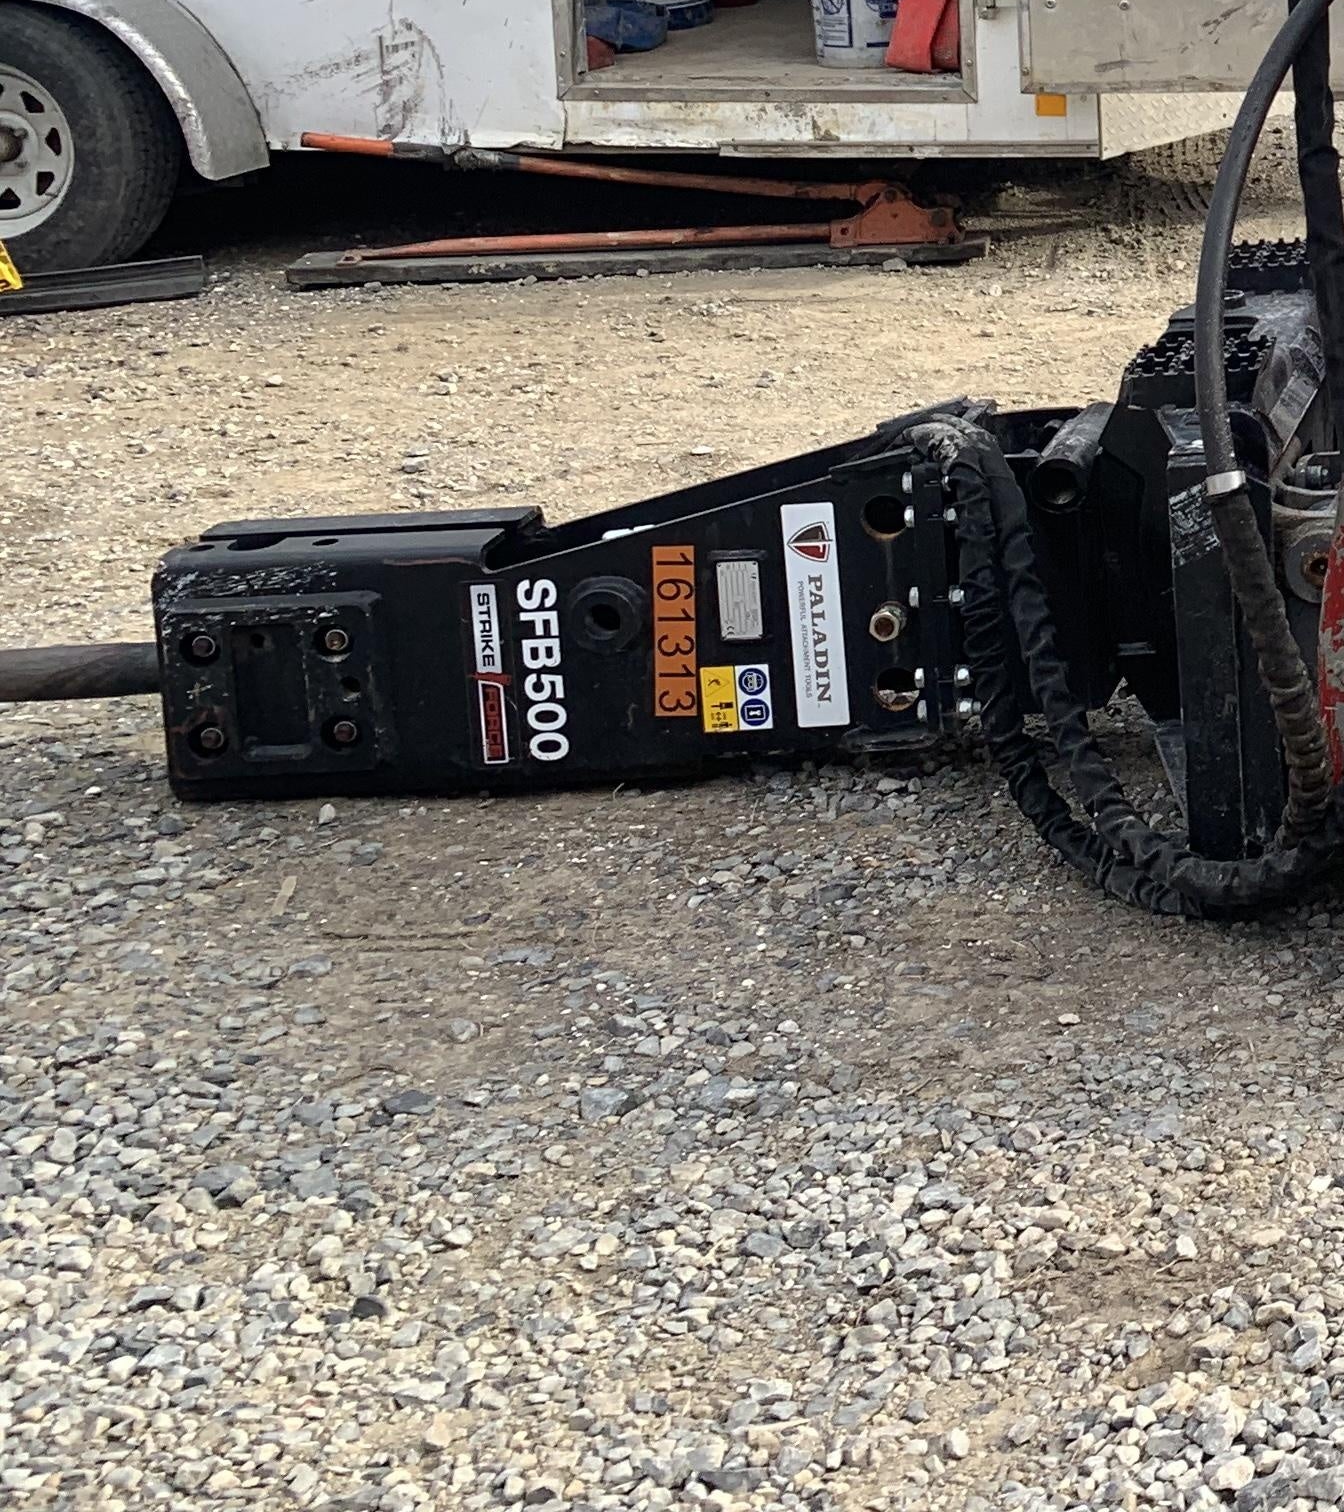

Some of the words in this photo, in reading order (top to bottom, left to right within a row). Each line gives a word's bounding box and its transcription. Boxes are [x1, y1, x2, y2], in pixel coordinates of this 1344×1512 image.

[476, 593, 495, 668] STRIKE
[656, 551, 696, 712] 161313
[797, 581, 806, 621] POWERFUL
[807, 574, 832, 703] PALADIN
[515, 578, 569, 762] SFB500
